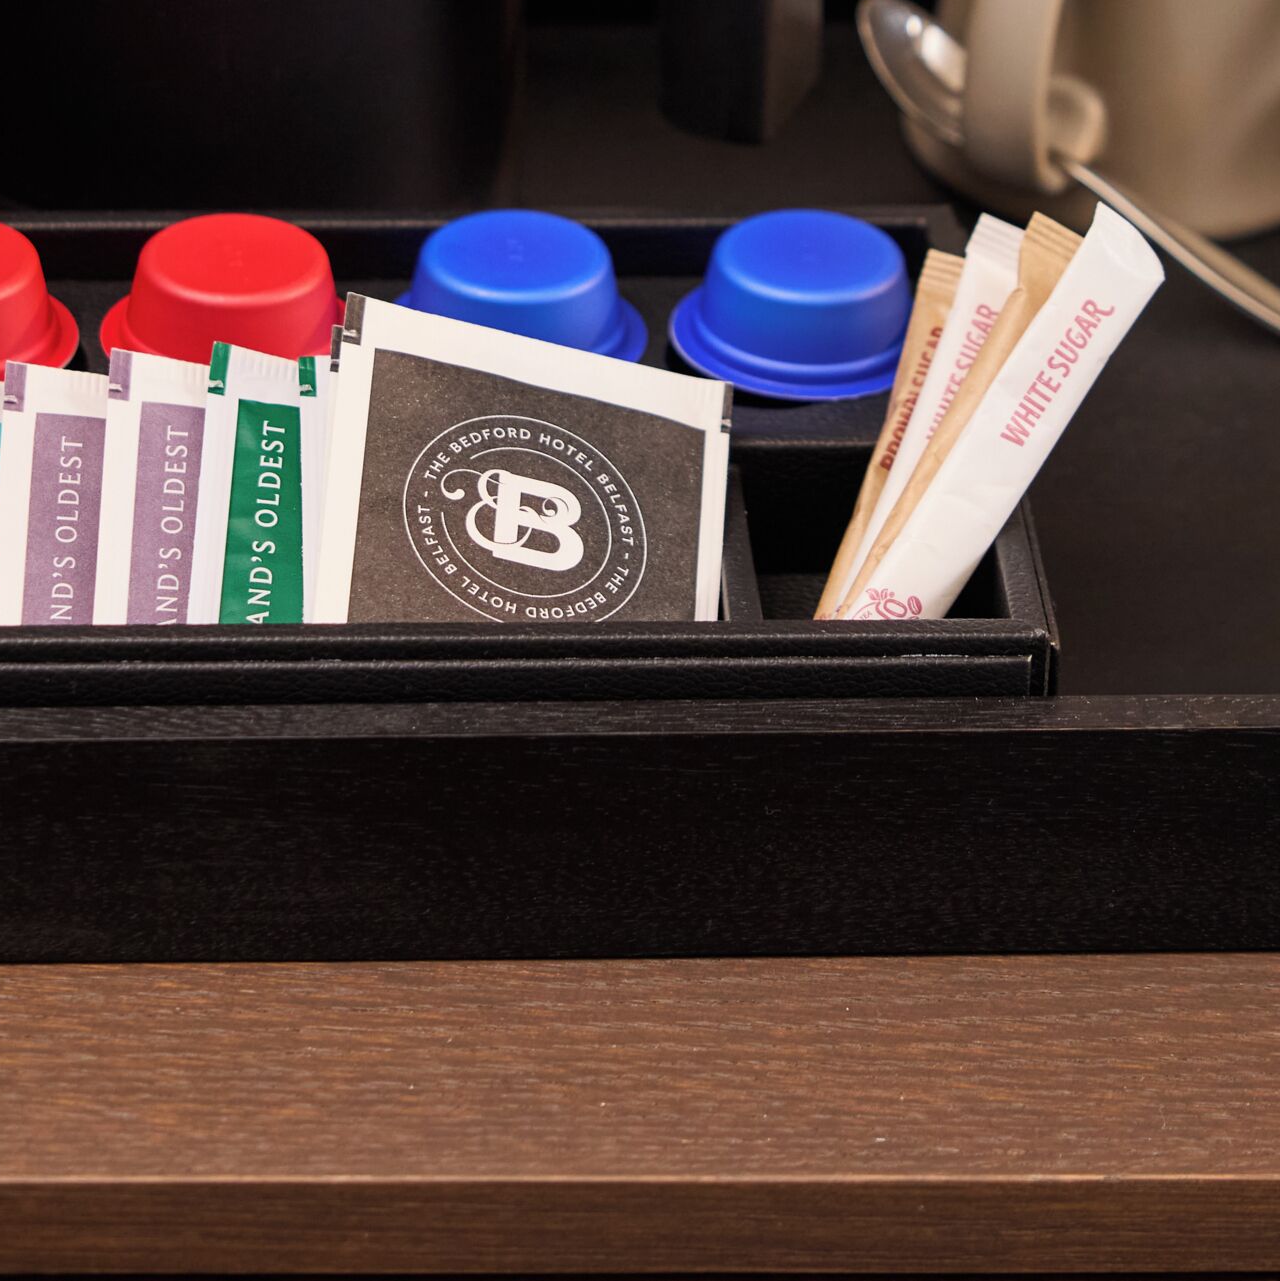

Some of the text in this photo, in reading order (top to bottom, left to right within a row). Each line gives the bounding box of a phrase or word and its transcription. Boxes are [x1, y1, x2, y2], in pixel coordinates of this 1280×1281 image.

[999, 297, 1116, 449] WHITE SUGAR
[55, 436, 84, 544] OLDEST
[157, 425, 189, 624] ND'S OLDEST
[254, 421, 286, 528] OLDEST
[423, 426, 635, 547] THE BEDFORD HOTEL BELFAST
[416, 504, 630, 620] THE BEDFORD HOTEL BELFAST
